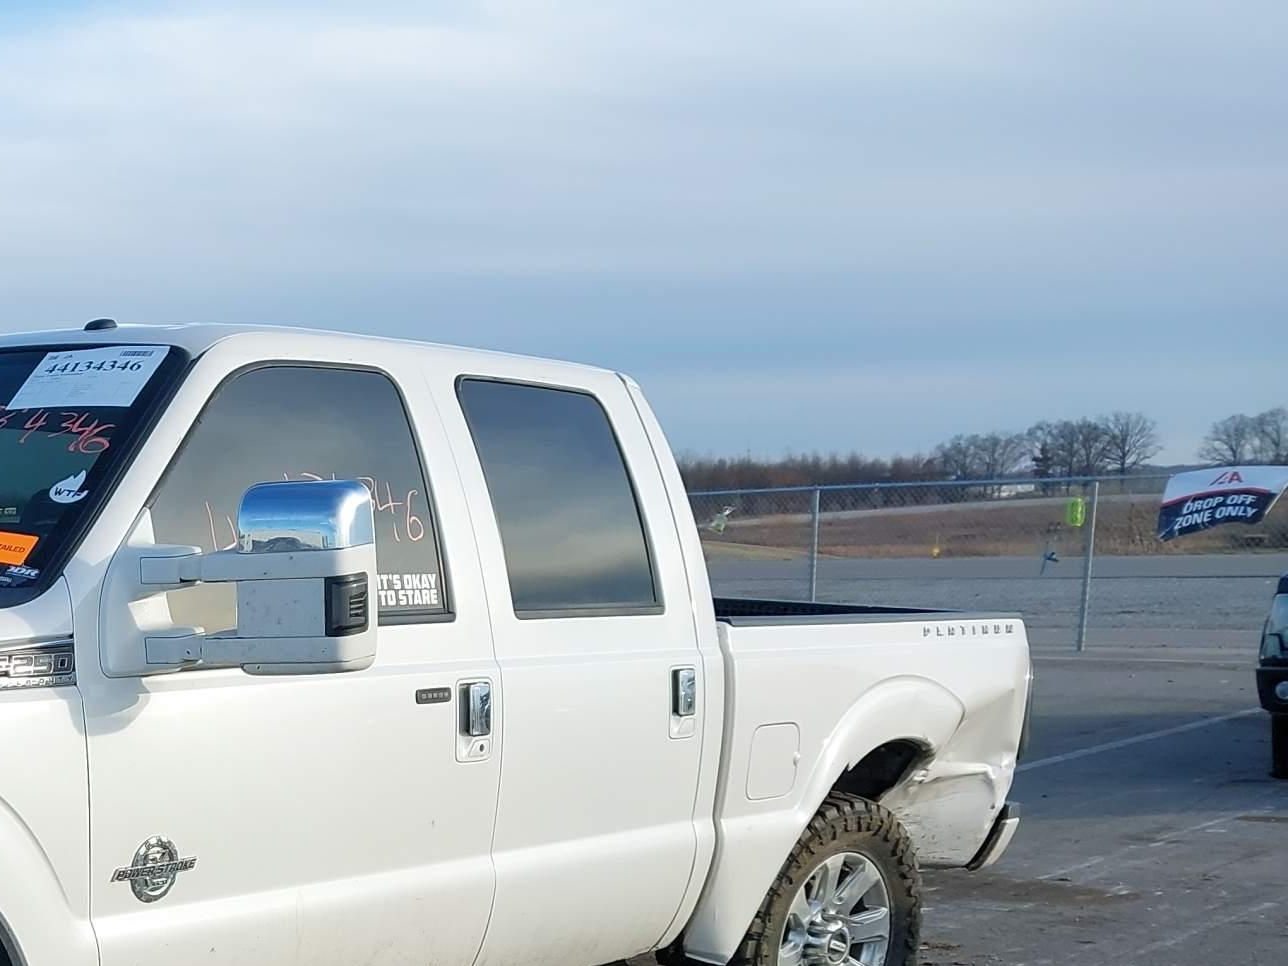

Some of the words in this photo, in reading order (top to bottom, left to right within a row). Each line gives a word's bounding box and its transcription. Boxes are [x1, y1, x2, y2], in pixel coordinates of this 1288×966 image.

[44, 360, 144, 374] 44134346
[1182, 496, 1224, 515] DROP
[1226, 494, 1258, 504] OFF
[1174, 509, 1213, 530] ZONE
[1215, 506, 1258, 518] ONLY
[376, 574, 402, 590] IT'S
[403, 573, 437, 590] OKAY
[378, 590, 397, 606] TO
[398, 589, 438, 606] STARE
